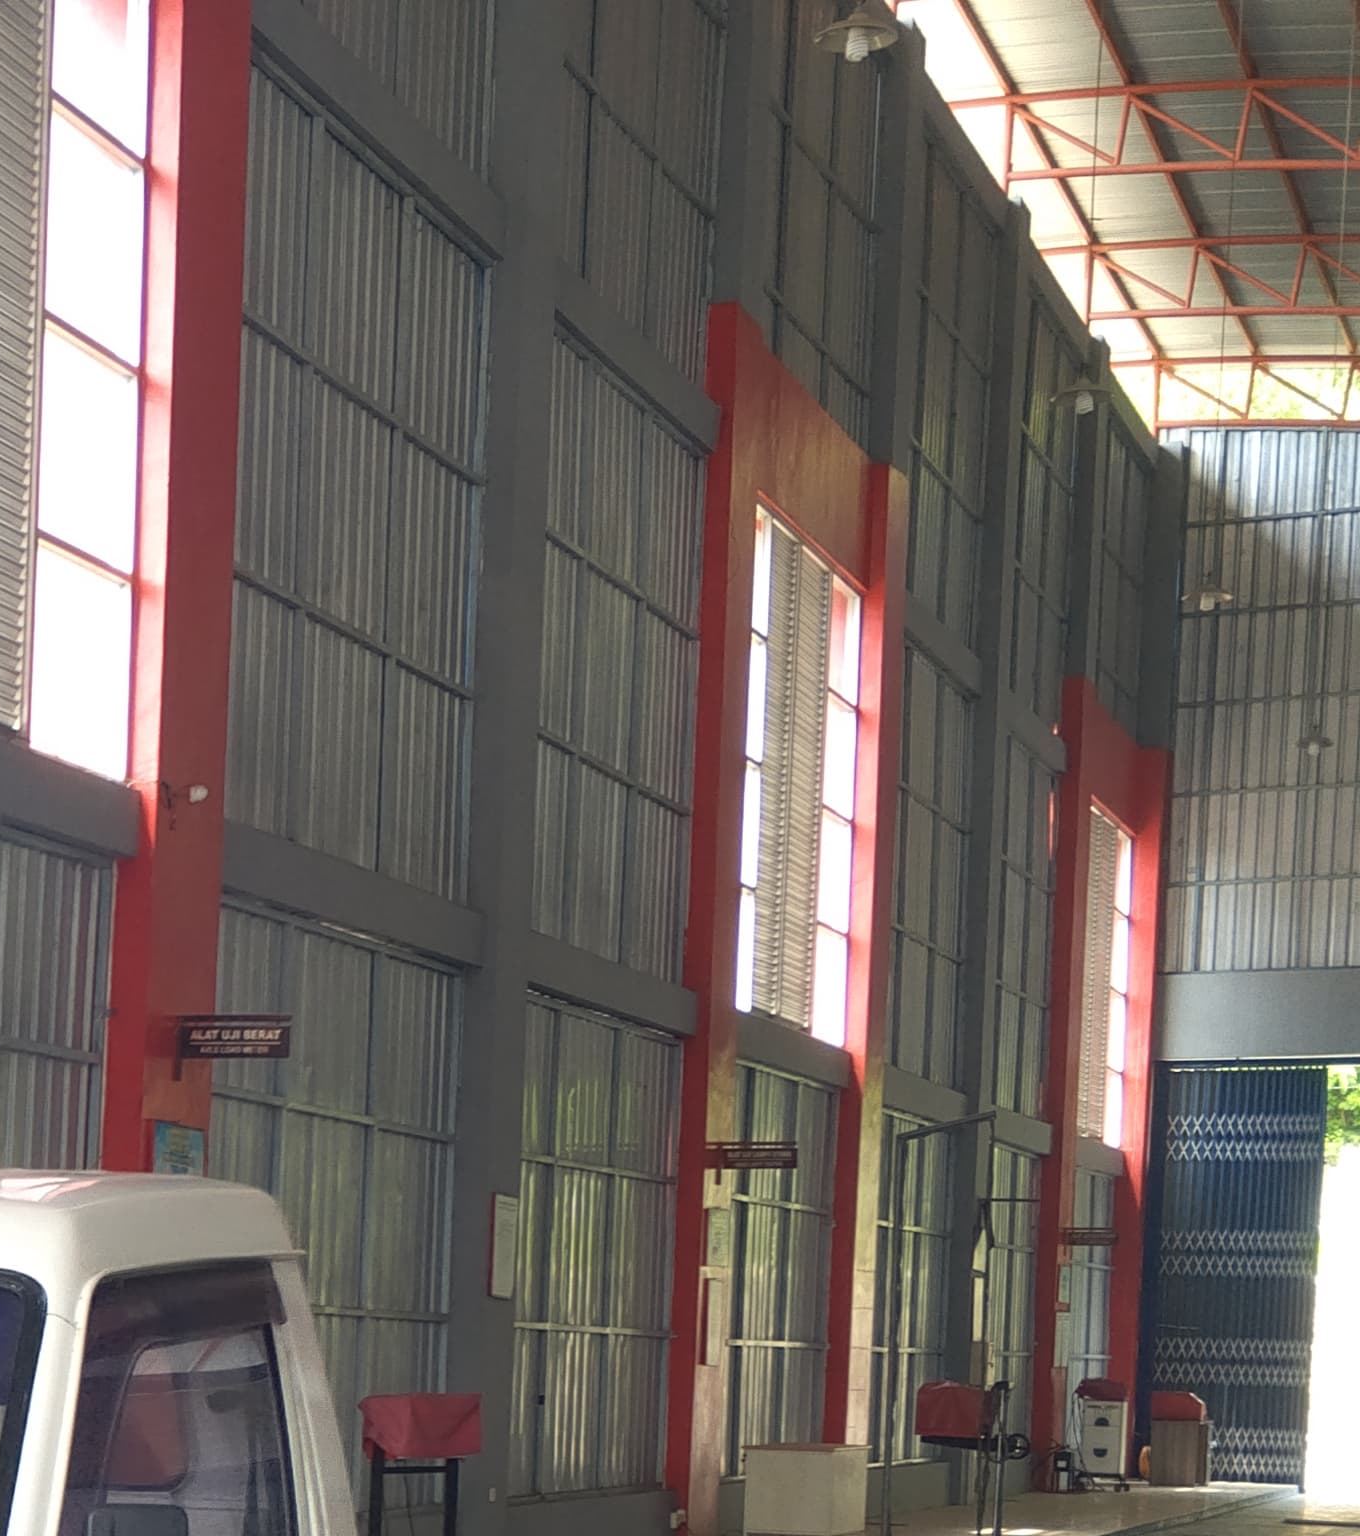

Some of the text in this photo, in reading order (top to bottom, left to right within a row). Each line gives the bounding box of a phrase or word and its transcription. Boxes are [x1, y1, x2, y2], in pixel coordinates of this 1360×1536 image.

[190, 1029, 281, 1040] ALAT UJI BERAT
